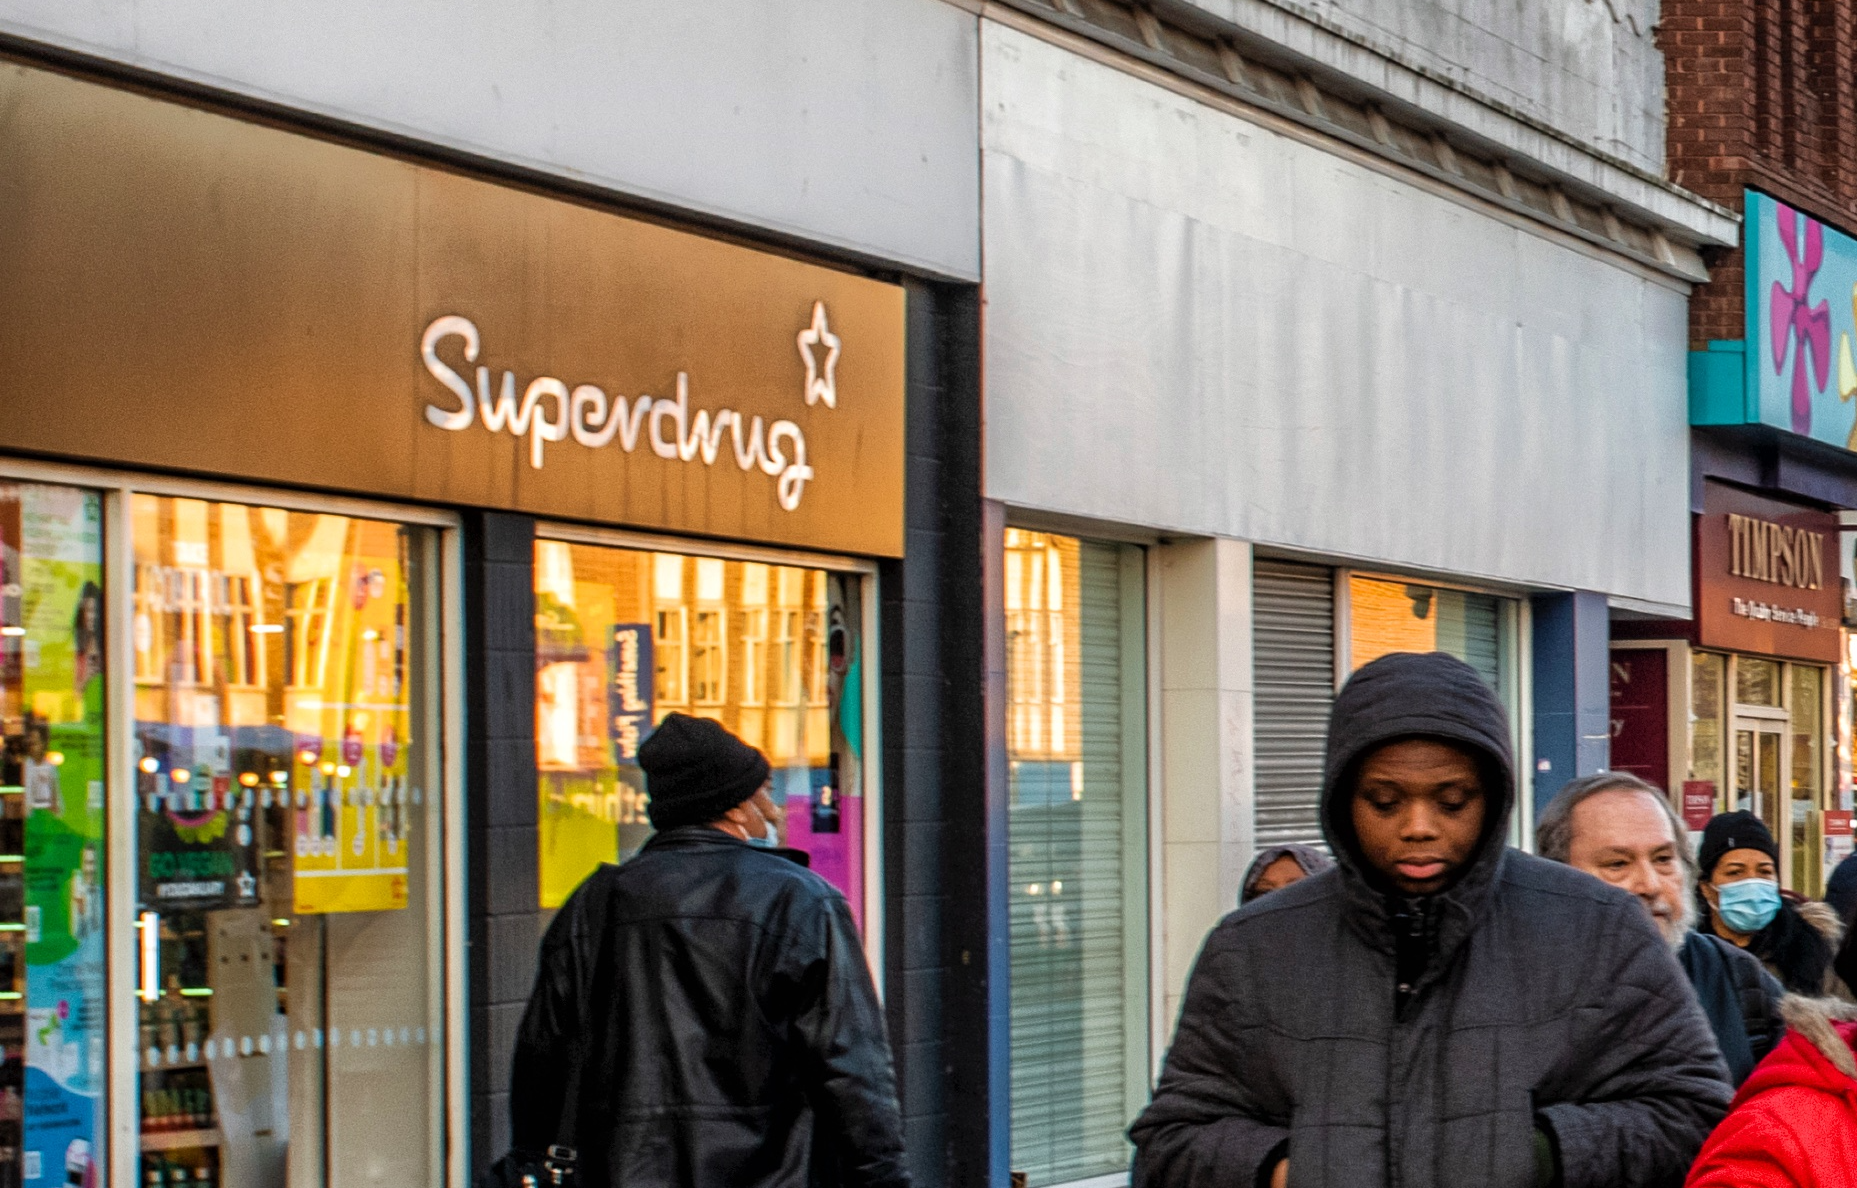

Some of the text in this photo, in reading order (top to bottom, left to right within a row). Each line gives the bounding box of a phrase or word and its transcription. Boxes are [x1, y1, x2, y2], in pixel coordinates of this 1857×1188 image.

[420, 315, 814, 511] Superdrug
[1727, 512, 1824, 590] TIMPSON
[1733, 596, 1748, 617] The
